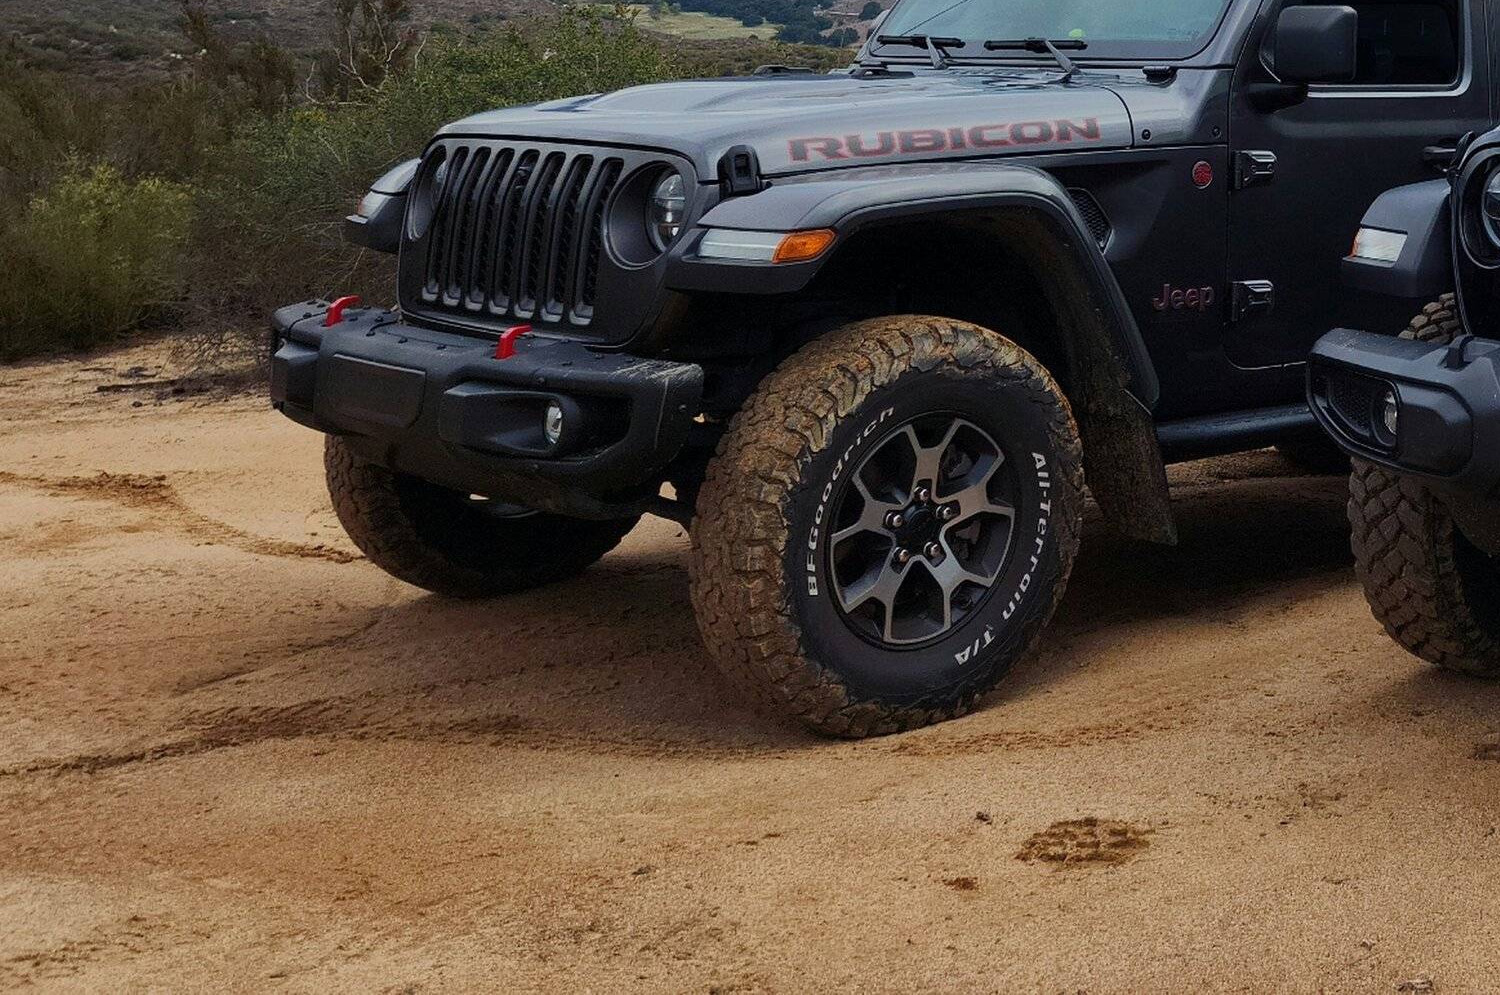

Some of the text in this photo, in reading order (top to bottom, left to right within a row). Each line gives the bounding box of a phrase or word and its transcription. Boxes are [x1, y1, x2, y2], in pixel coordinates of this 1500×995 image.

[788, 117, 1101, 164] RUBICON
[1153, 283, 1215, 313] Jeep
[807, 407, 895, 596] BFGoodrich
[954, 452, 1051, 666] All-Terrain T/A
